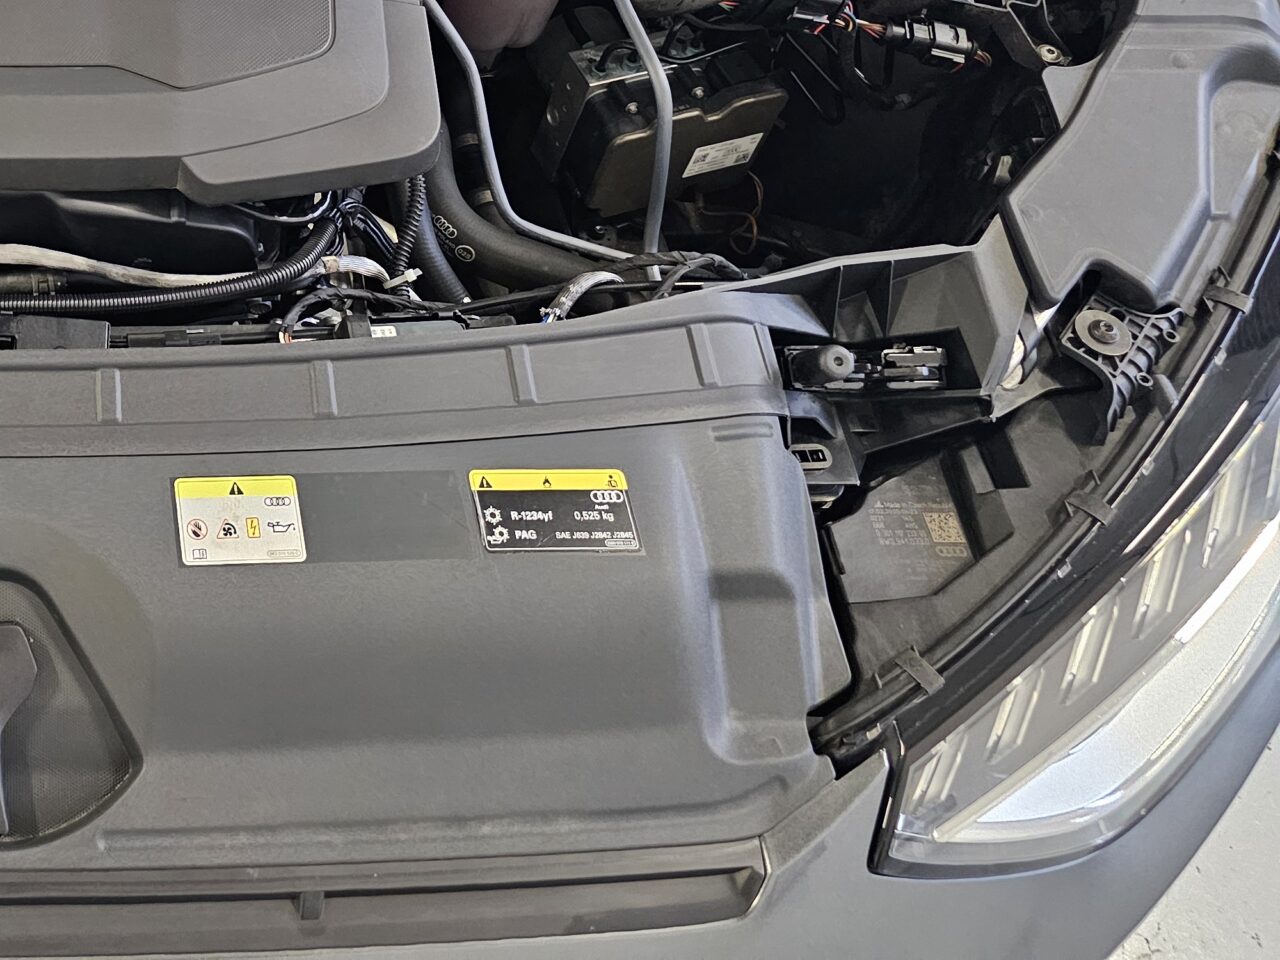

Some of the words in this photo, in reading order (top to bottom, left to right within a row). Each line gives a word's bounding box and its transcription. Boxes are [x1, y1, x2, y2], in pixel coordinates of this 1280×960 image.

[510, 510, 554, 522] R-1234yf
[573, 510, 601, 522] 0,525
[601, 510, 615, 523] kg
[514, 529, 538, 540] PAG
[555, 531, 571, 539] SAE
